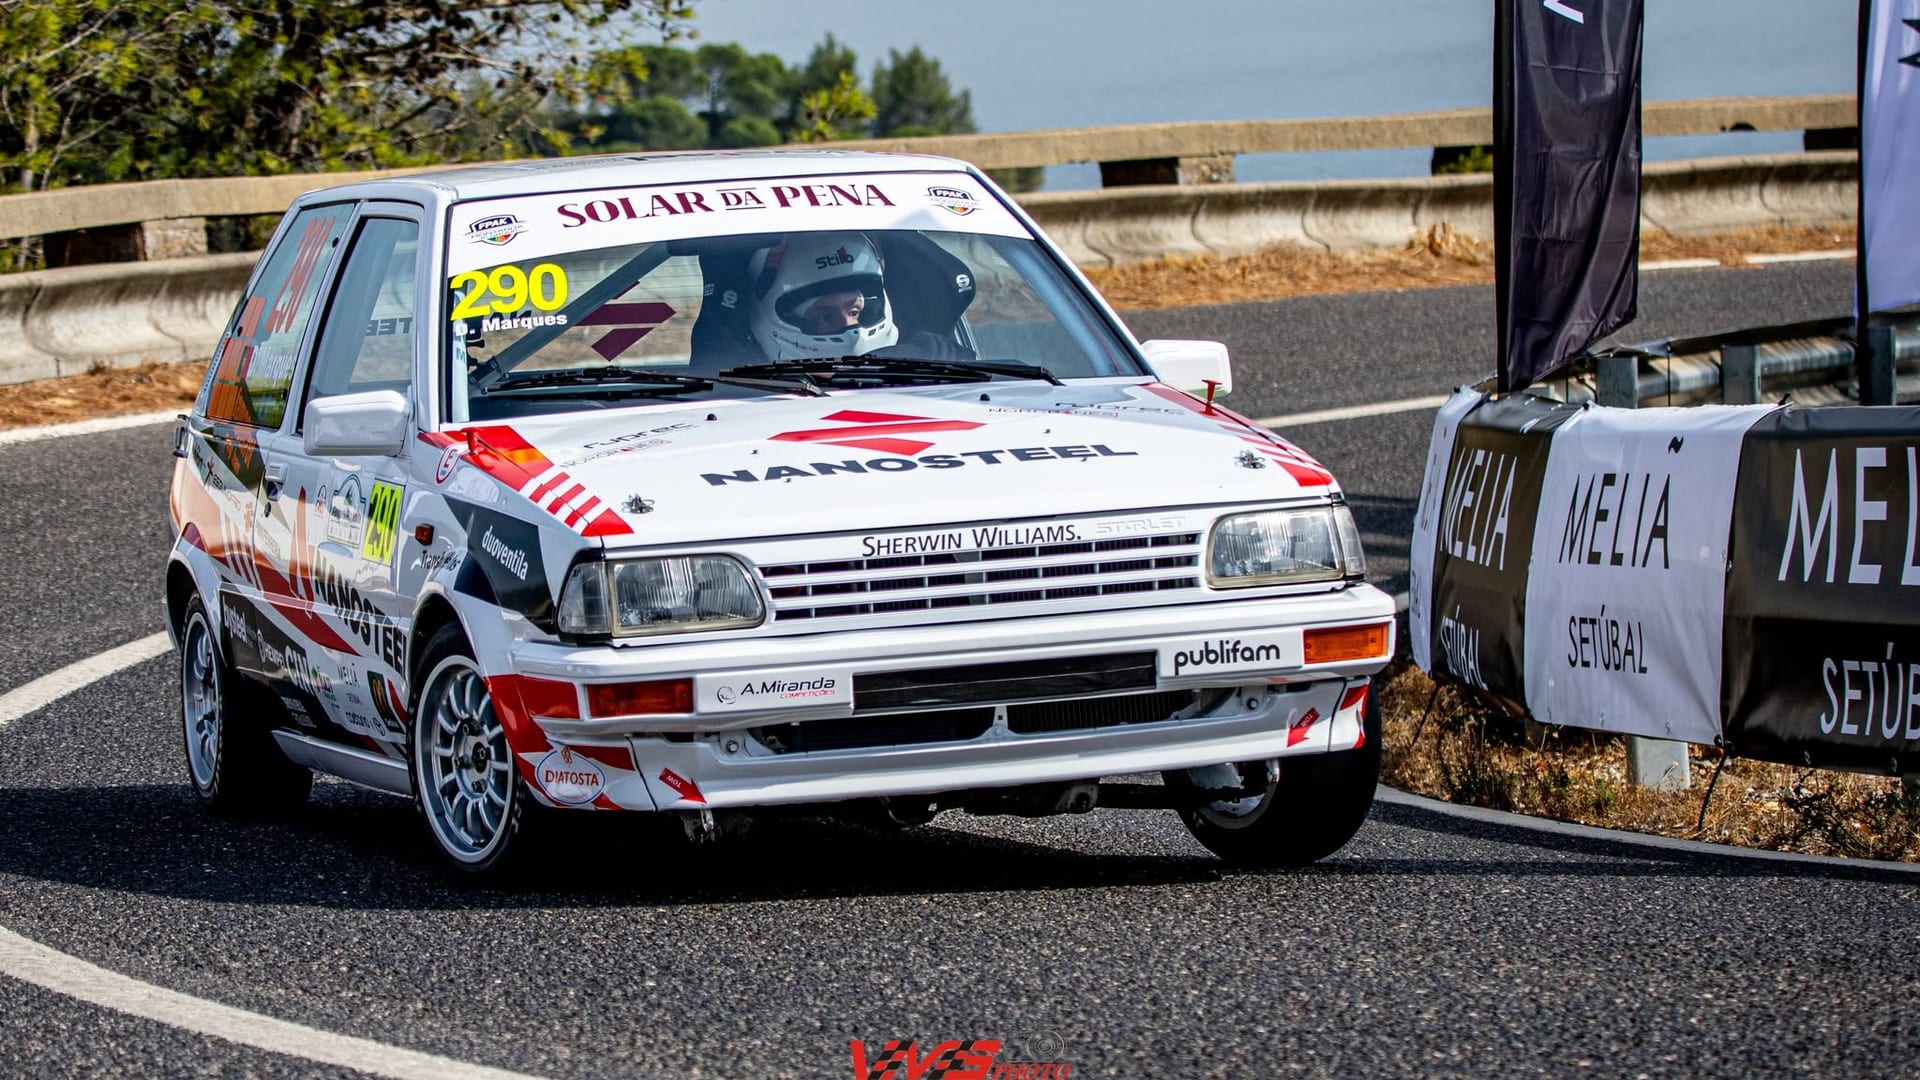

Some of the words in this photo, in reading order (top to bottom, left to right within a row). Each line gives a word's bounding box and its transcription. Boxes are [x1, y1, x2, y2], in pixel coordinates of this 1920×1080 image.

[557, 191, 714, 228] SOLAR
[720, 189, 765, 209] DA
[771, 183, 897, 209] PENA
[936, 189, 965, 200] FPAK
[478, 217, 508, 231] FPAK
[264, 215, 336, 334] 290
[450, 263, 568, 321] 290
[482, 313, 568, 333] Marques
[700, 443, 1139, 486] NANOSTEEL
[363, 480, 403, 566] 290
[481, 525, 529, 581] duoventila
[862, 532, 963, 558] SHERWIN
[1174, 639, 1281, 676] publifam
[1567, 605, 1649, 675] SETÚBAL
[285, 646, 315, 696] CIN
[740, 676, 836, 697] A.Miranda
[544, 769, 599, 787] DIATOSTA
[667, 774, 683, 790] TOW
